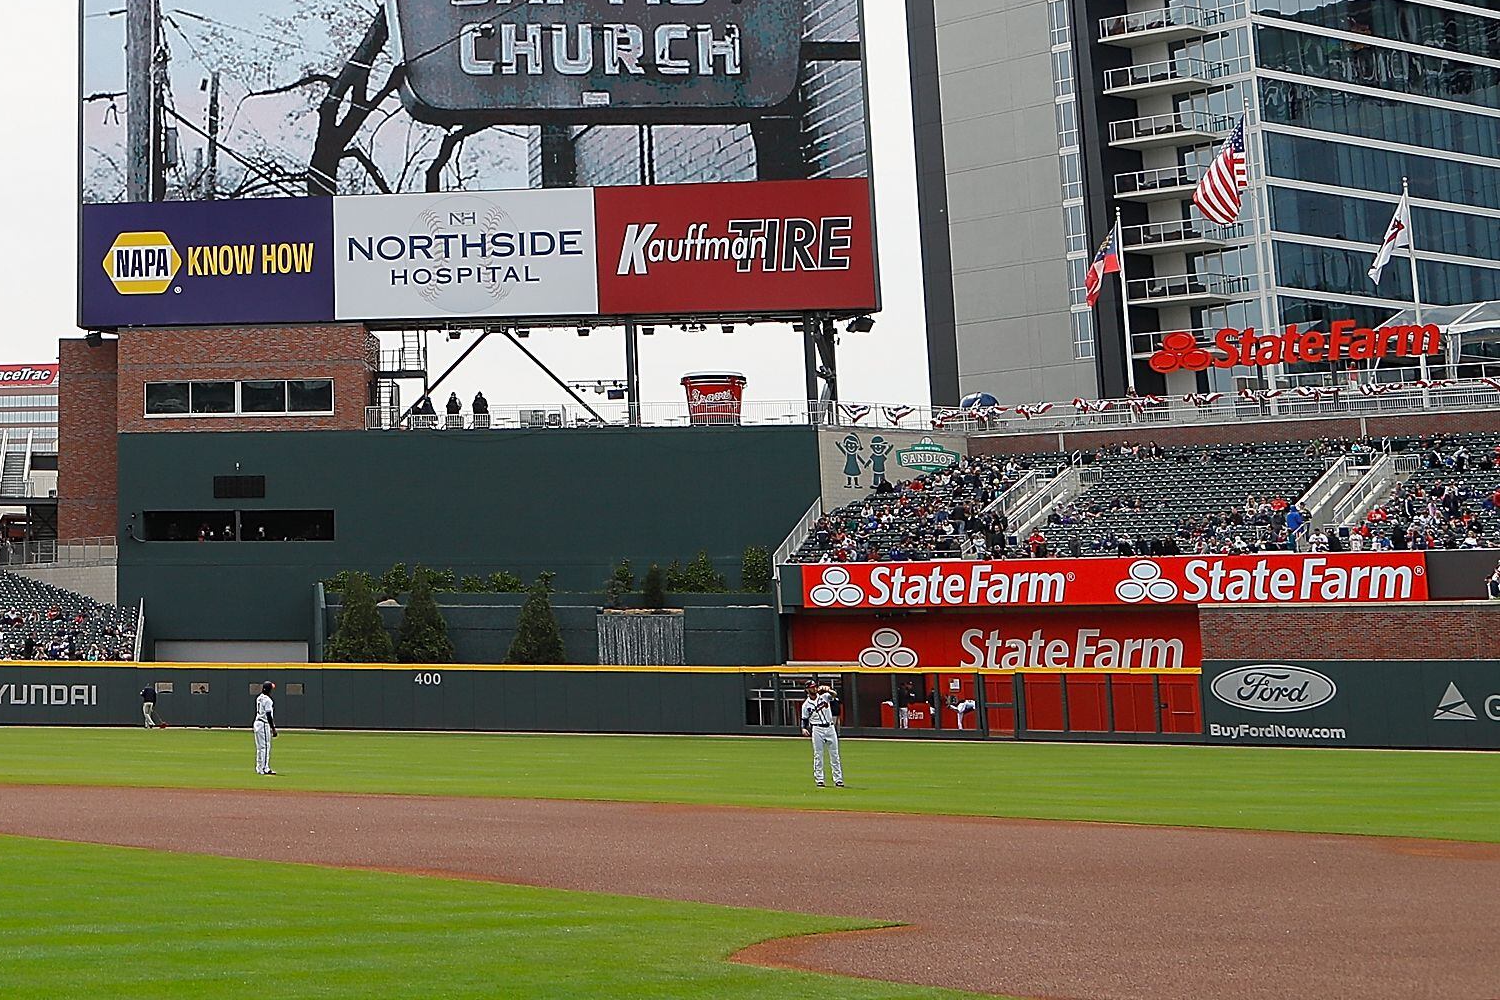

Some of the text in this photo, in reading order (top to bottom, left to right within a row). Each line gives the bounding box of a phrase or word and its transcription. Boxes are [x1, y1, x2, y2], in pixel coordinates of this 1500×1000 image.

[459, 21, 742, 77] CHURCH
[187, 242, 314, 277] KNOW HOW
[347, 230, 583, 262] NORTHSIDE
[616, 216, 853, 275] Kauffman TIRE
[115, 247, 169, 278] NAPA
[390, 265, 541, 286] HOSPITAL
[902, 452, 956, 465] SANDLOT
[414, 672, 442, 686] 400
[1236, 672, 1309, 703] Ford
[1209, 723, 1346, 740] BuyFordNow.com
